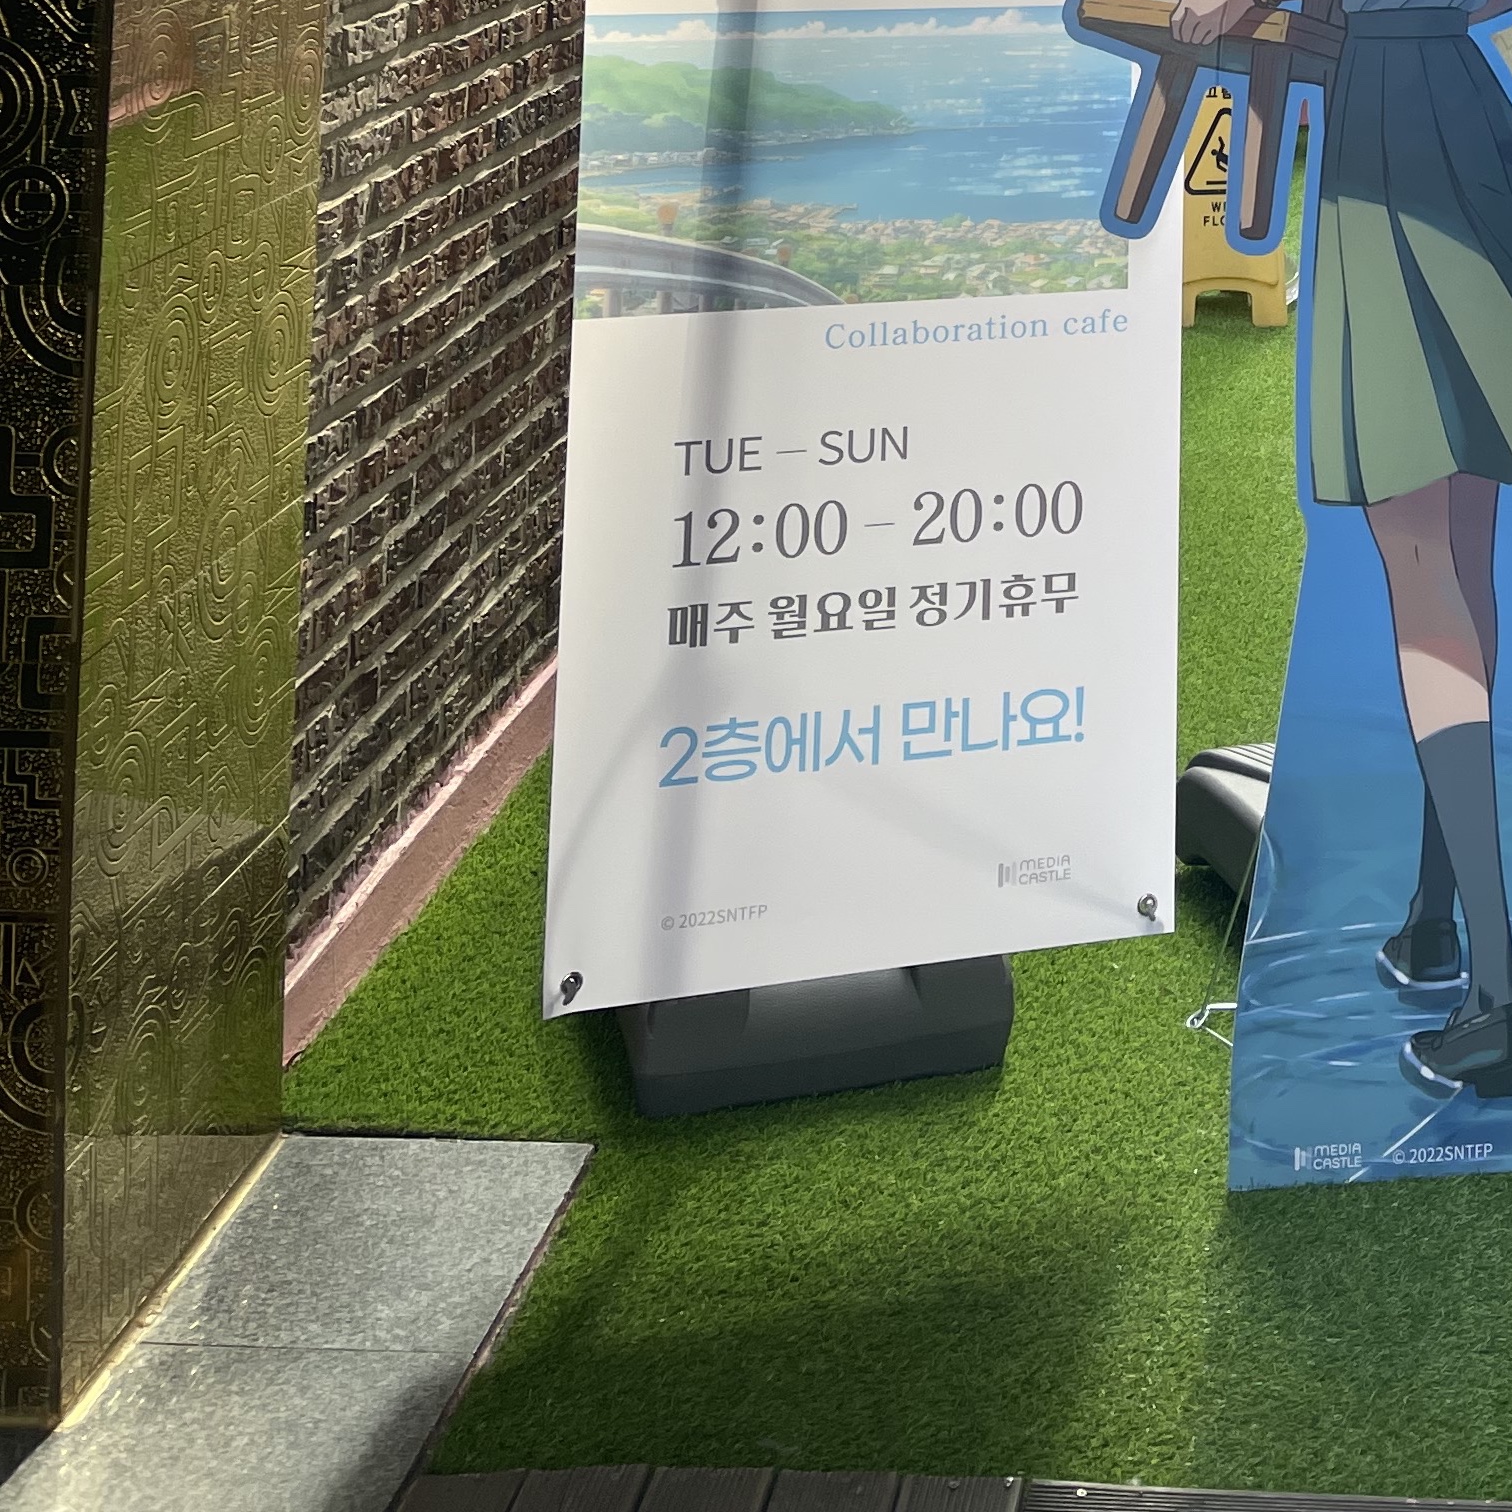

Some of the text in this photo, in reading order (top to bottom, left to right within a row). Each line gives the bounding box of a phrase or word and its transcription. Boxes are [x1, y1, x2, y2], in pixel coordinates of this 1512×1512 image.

[824, 308, 1129, 349] Collaboration cafe
[674, 436, 763, 476] TUE
[818, 426, 909, 465] SUN
[672, 499, 848, 567] 12:00
[912, 480, 1083, 546] 20:00
[667, 572, 1079, 648] 매주 월요일 정기휴무
[658, 686, 1085, 788] 2층에서 만나요!
[1019, 868, 1071, 884] CASTLE
[1020, 855, 1071, 870] MEDIA
[1313, 1156, 1362, 1170] CASTLE
[1314, 1143, 1361, 1157] MEDIA
